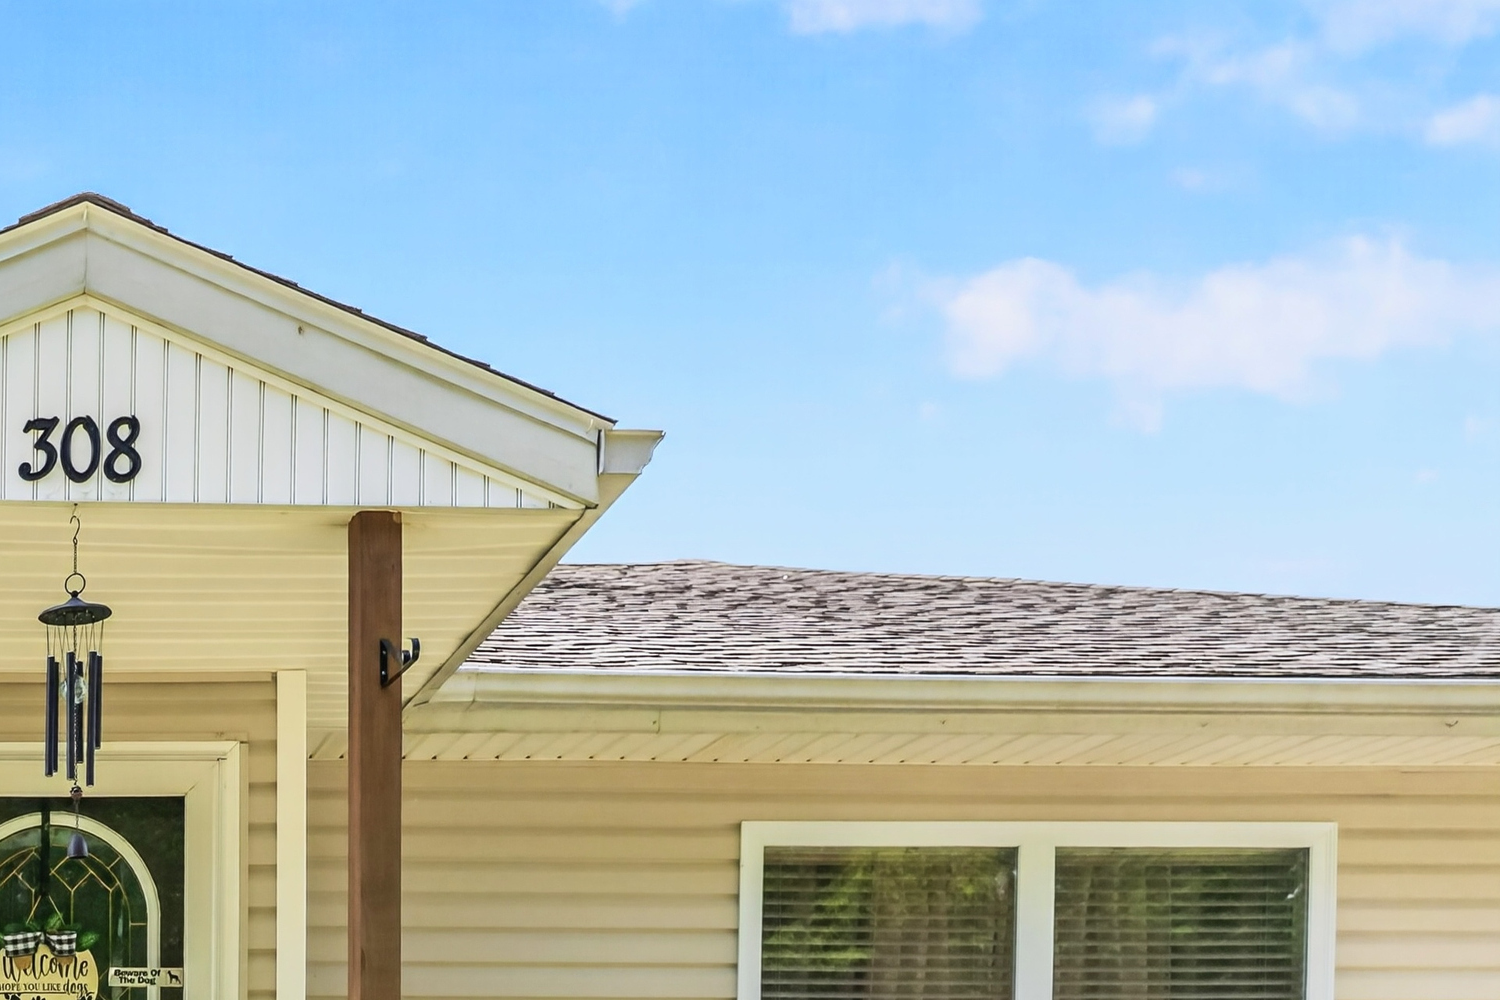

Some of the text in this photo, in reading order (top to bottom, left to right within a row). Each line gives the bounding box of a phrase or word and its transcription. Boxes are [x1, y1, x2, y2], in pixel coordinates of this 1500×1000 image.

[18, 415, 142, 483] 308
[113, 969, 161, 977] Beware Of
[23, 983, 41, 991] YOU
[42, 983, 61, 991] LIKE
[62, 978, 89, 998] dogs
[118, 976, 157, 986] The Dog
